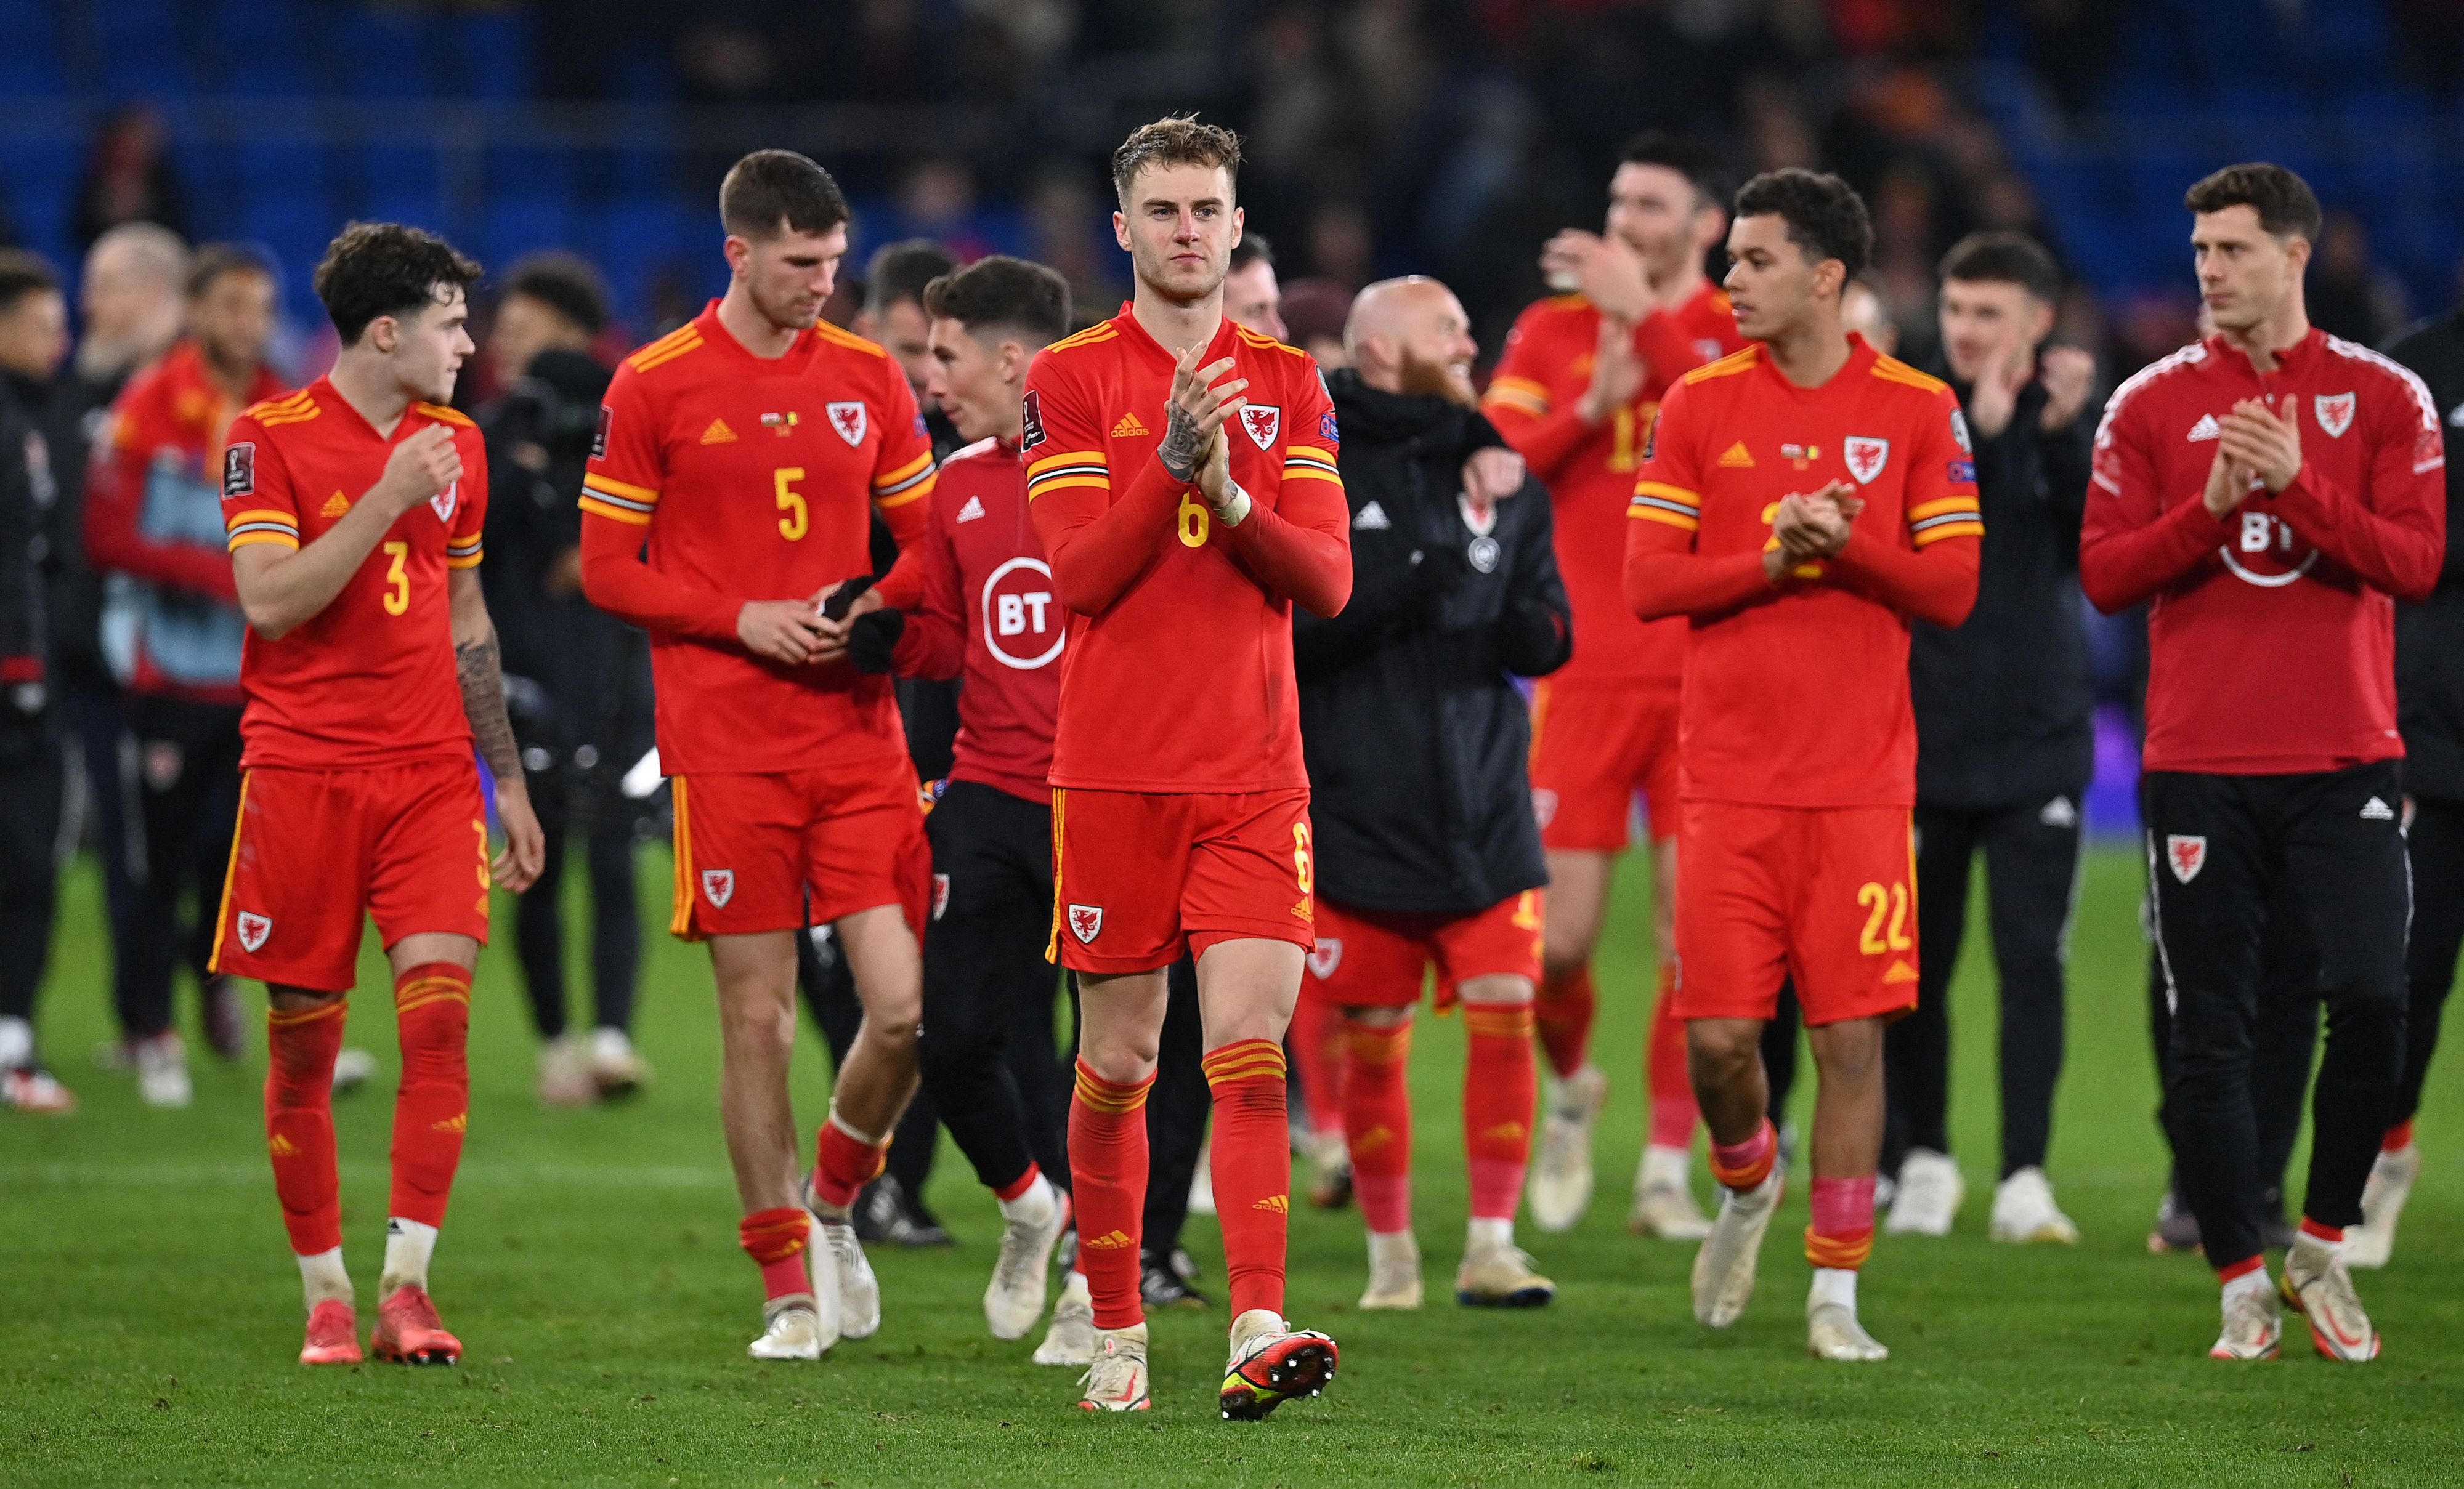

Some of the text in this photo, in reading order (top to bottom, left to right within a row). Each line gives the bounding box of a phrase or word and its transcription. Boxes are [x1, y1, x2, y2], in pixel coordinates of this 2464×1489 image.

[1111, 427, 1149, 438] adidas
[774, 467, 808, 541] 5
[1178, 491, 1209, 547] 6
[383, 541, 410, 616] 3
[998, 591, 1052, 636] BT
[1292, 821, 1311, 894] 6
[1857, 880, 1912, 955] 22
